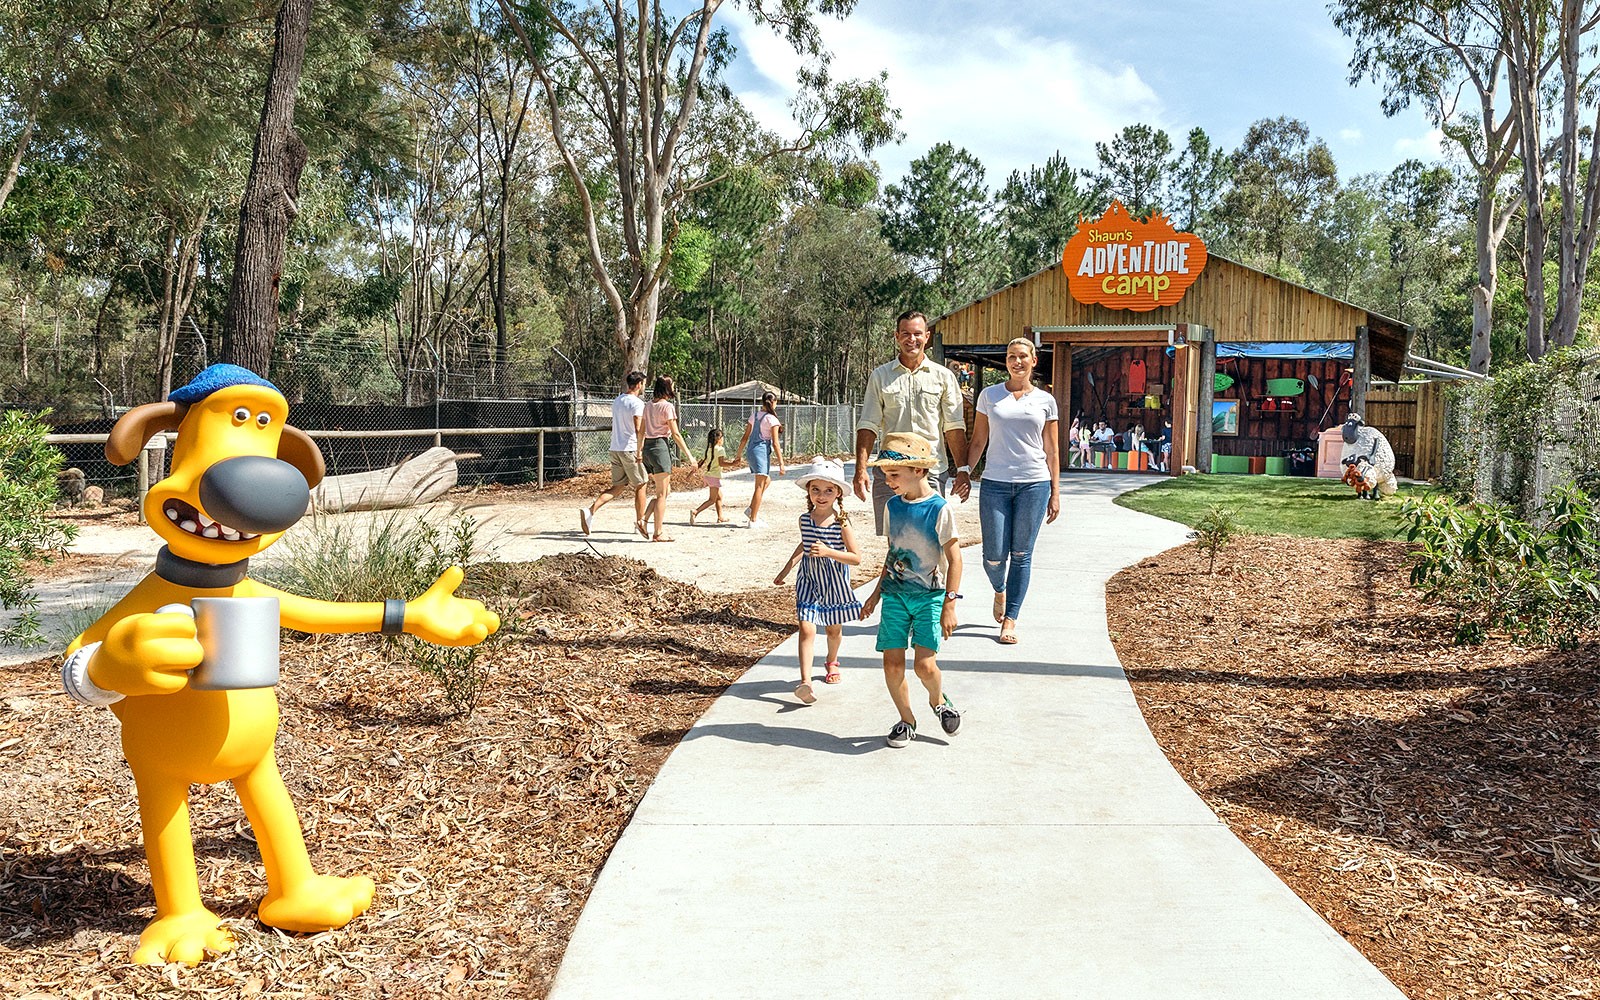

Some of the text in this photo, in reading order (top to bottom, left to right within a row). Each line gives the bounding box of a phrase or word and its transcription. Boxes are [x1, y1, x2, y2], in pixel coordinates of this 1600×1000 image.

[1088, 229, 1133, 243] Shaun's
[1077, 240, 1190, 277] ADVENTURE
[1102, 275, 1170, 301] camp
